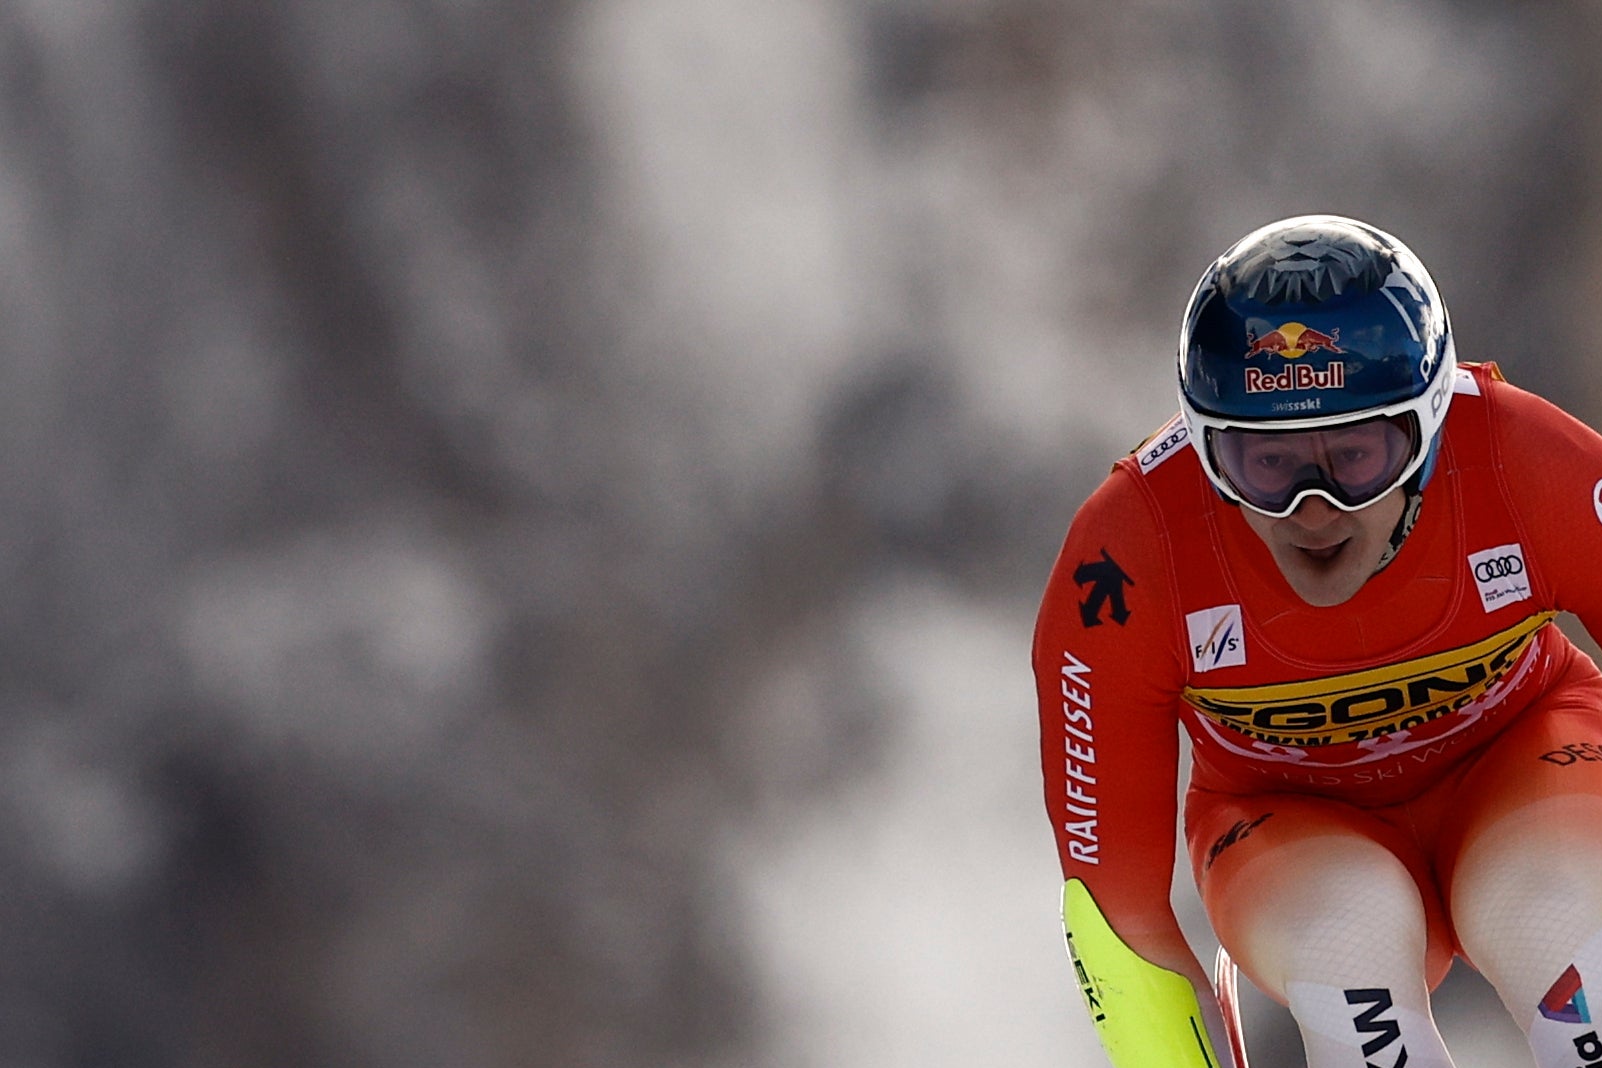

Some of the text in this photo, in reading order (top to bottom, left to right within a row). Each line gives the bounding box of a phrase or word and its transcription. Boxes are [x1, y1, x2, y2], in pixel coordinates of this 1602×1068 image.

[1245, 361, 1344, 393] Red Bull
[1061, 651, 1099, 865] RAIFFEISEN
